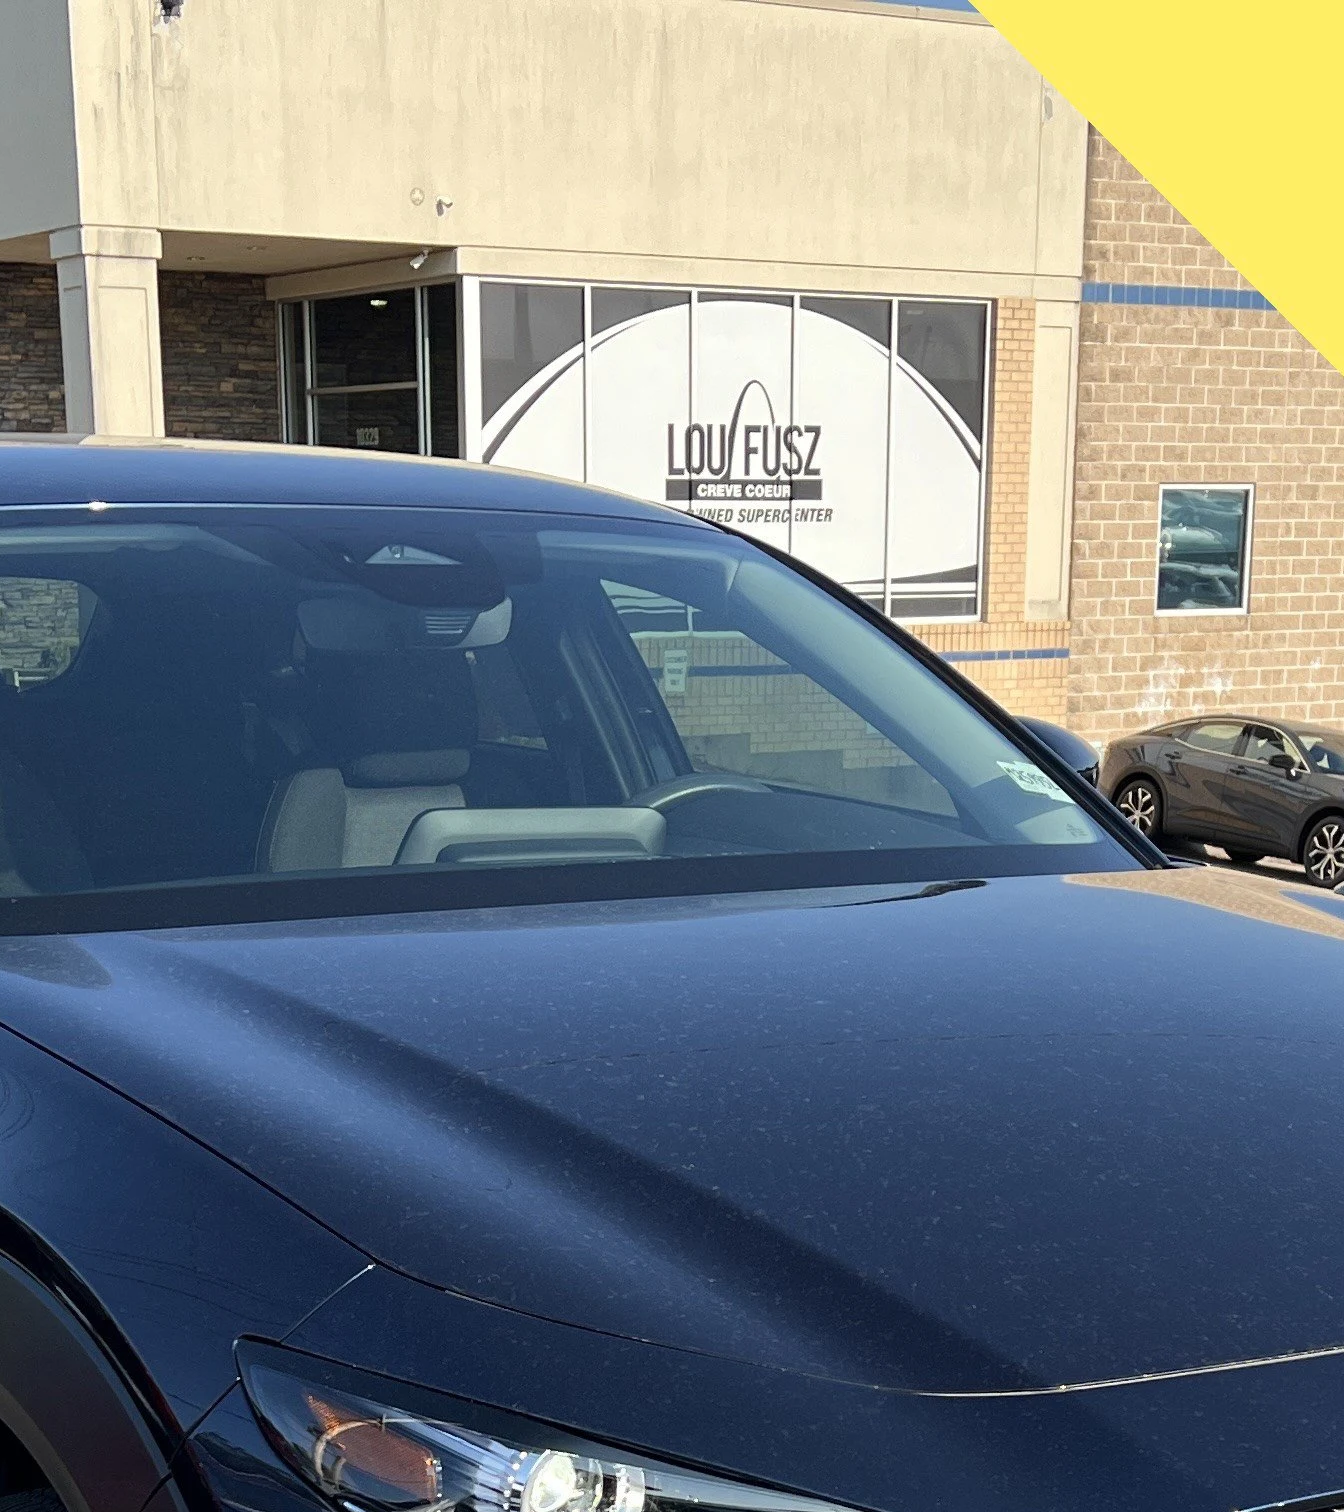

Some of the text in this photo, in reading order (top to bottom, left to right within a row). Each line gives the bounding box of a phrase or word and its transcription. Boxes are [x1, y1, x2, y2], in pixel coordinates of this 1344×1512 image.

[667, 422, 822, 477] LOU FUSZ
[696, 483, 792, 499] CREVE COEUR
